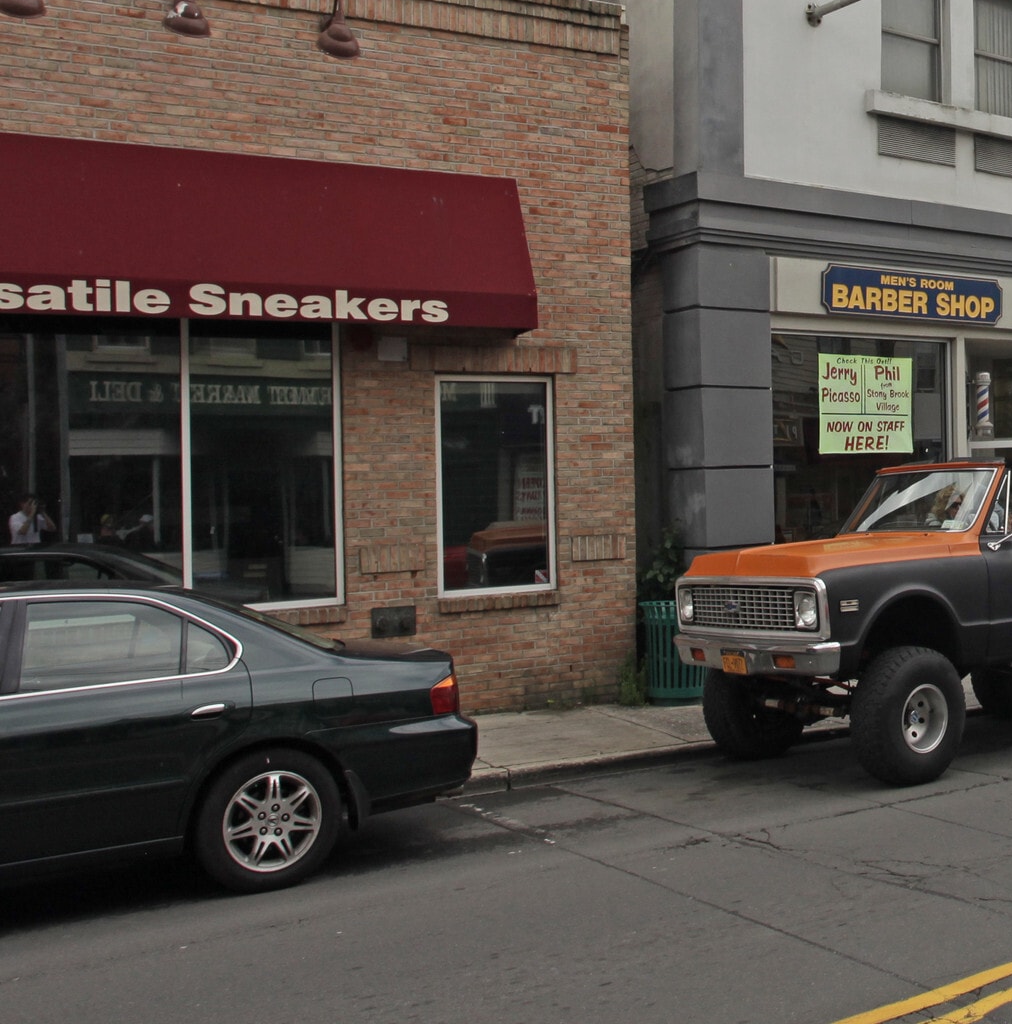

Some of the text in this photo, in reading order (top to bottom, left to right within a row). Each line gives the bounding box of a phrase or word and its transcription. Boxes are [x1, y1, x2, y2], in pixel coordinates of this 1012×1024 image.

[880, 274, 954, 291] MEN'S ROOM
[188, 283, 450, 323] Sneakers
[831, 283, 995, 319] BARBER SHOP
[836, 357, 857, 365] Check
[821, 362, 858, 386] Jerry
[874, 365, 901, 381] Phil
[821, 387, 861, 403] Picasso
[866, 388, 910, 400] Stony Brook
[876, 402, 900, 413] Village
[826, 421, 905, 432] NOW ON STAFF
[844, 435, 889, 452] HERE!
